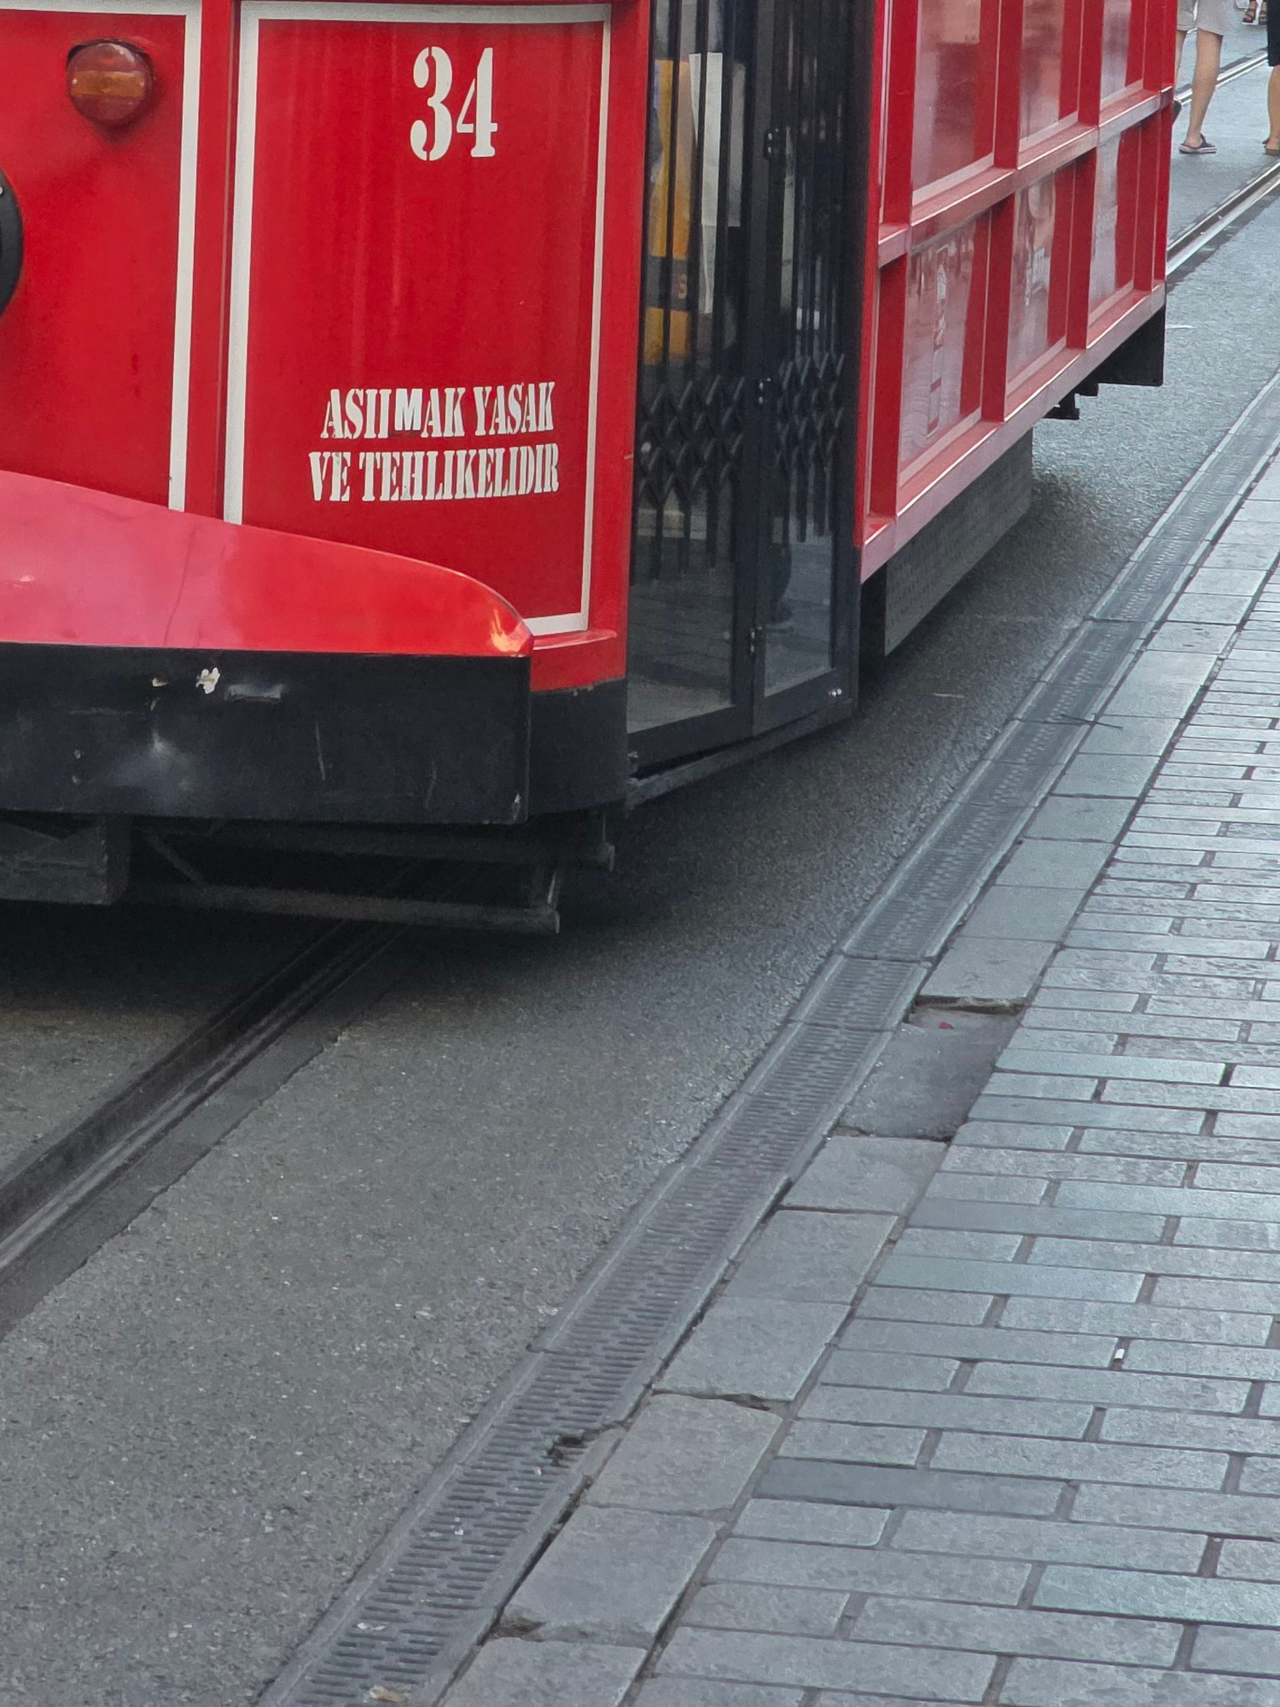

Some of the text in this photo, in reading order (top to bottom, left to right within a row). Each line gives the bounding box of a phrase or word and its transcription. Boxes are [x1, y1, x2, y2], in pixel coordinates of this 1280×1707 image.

[410, 46, 498, 161] 34
[473, 381, 556, 436] YASAK
[308, 442, 560, 502] VE TEHLIKELIDIR
